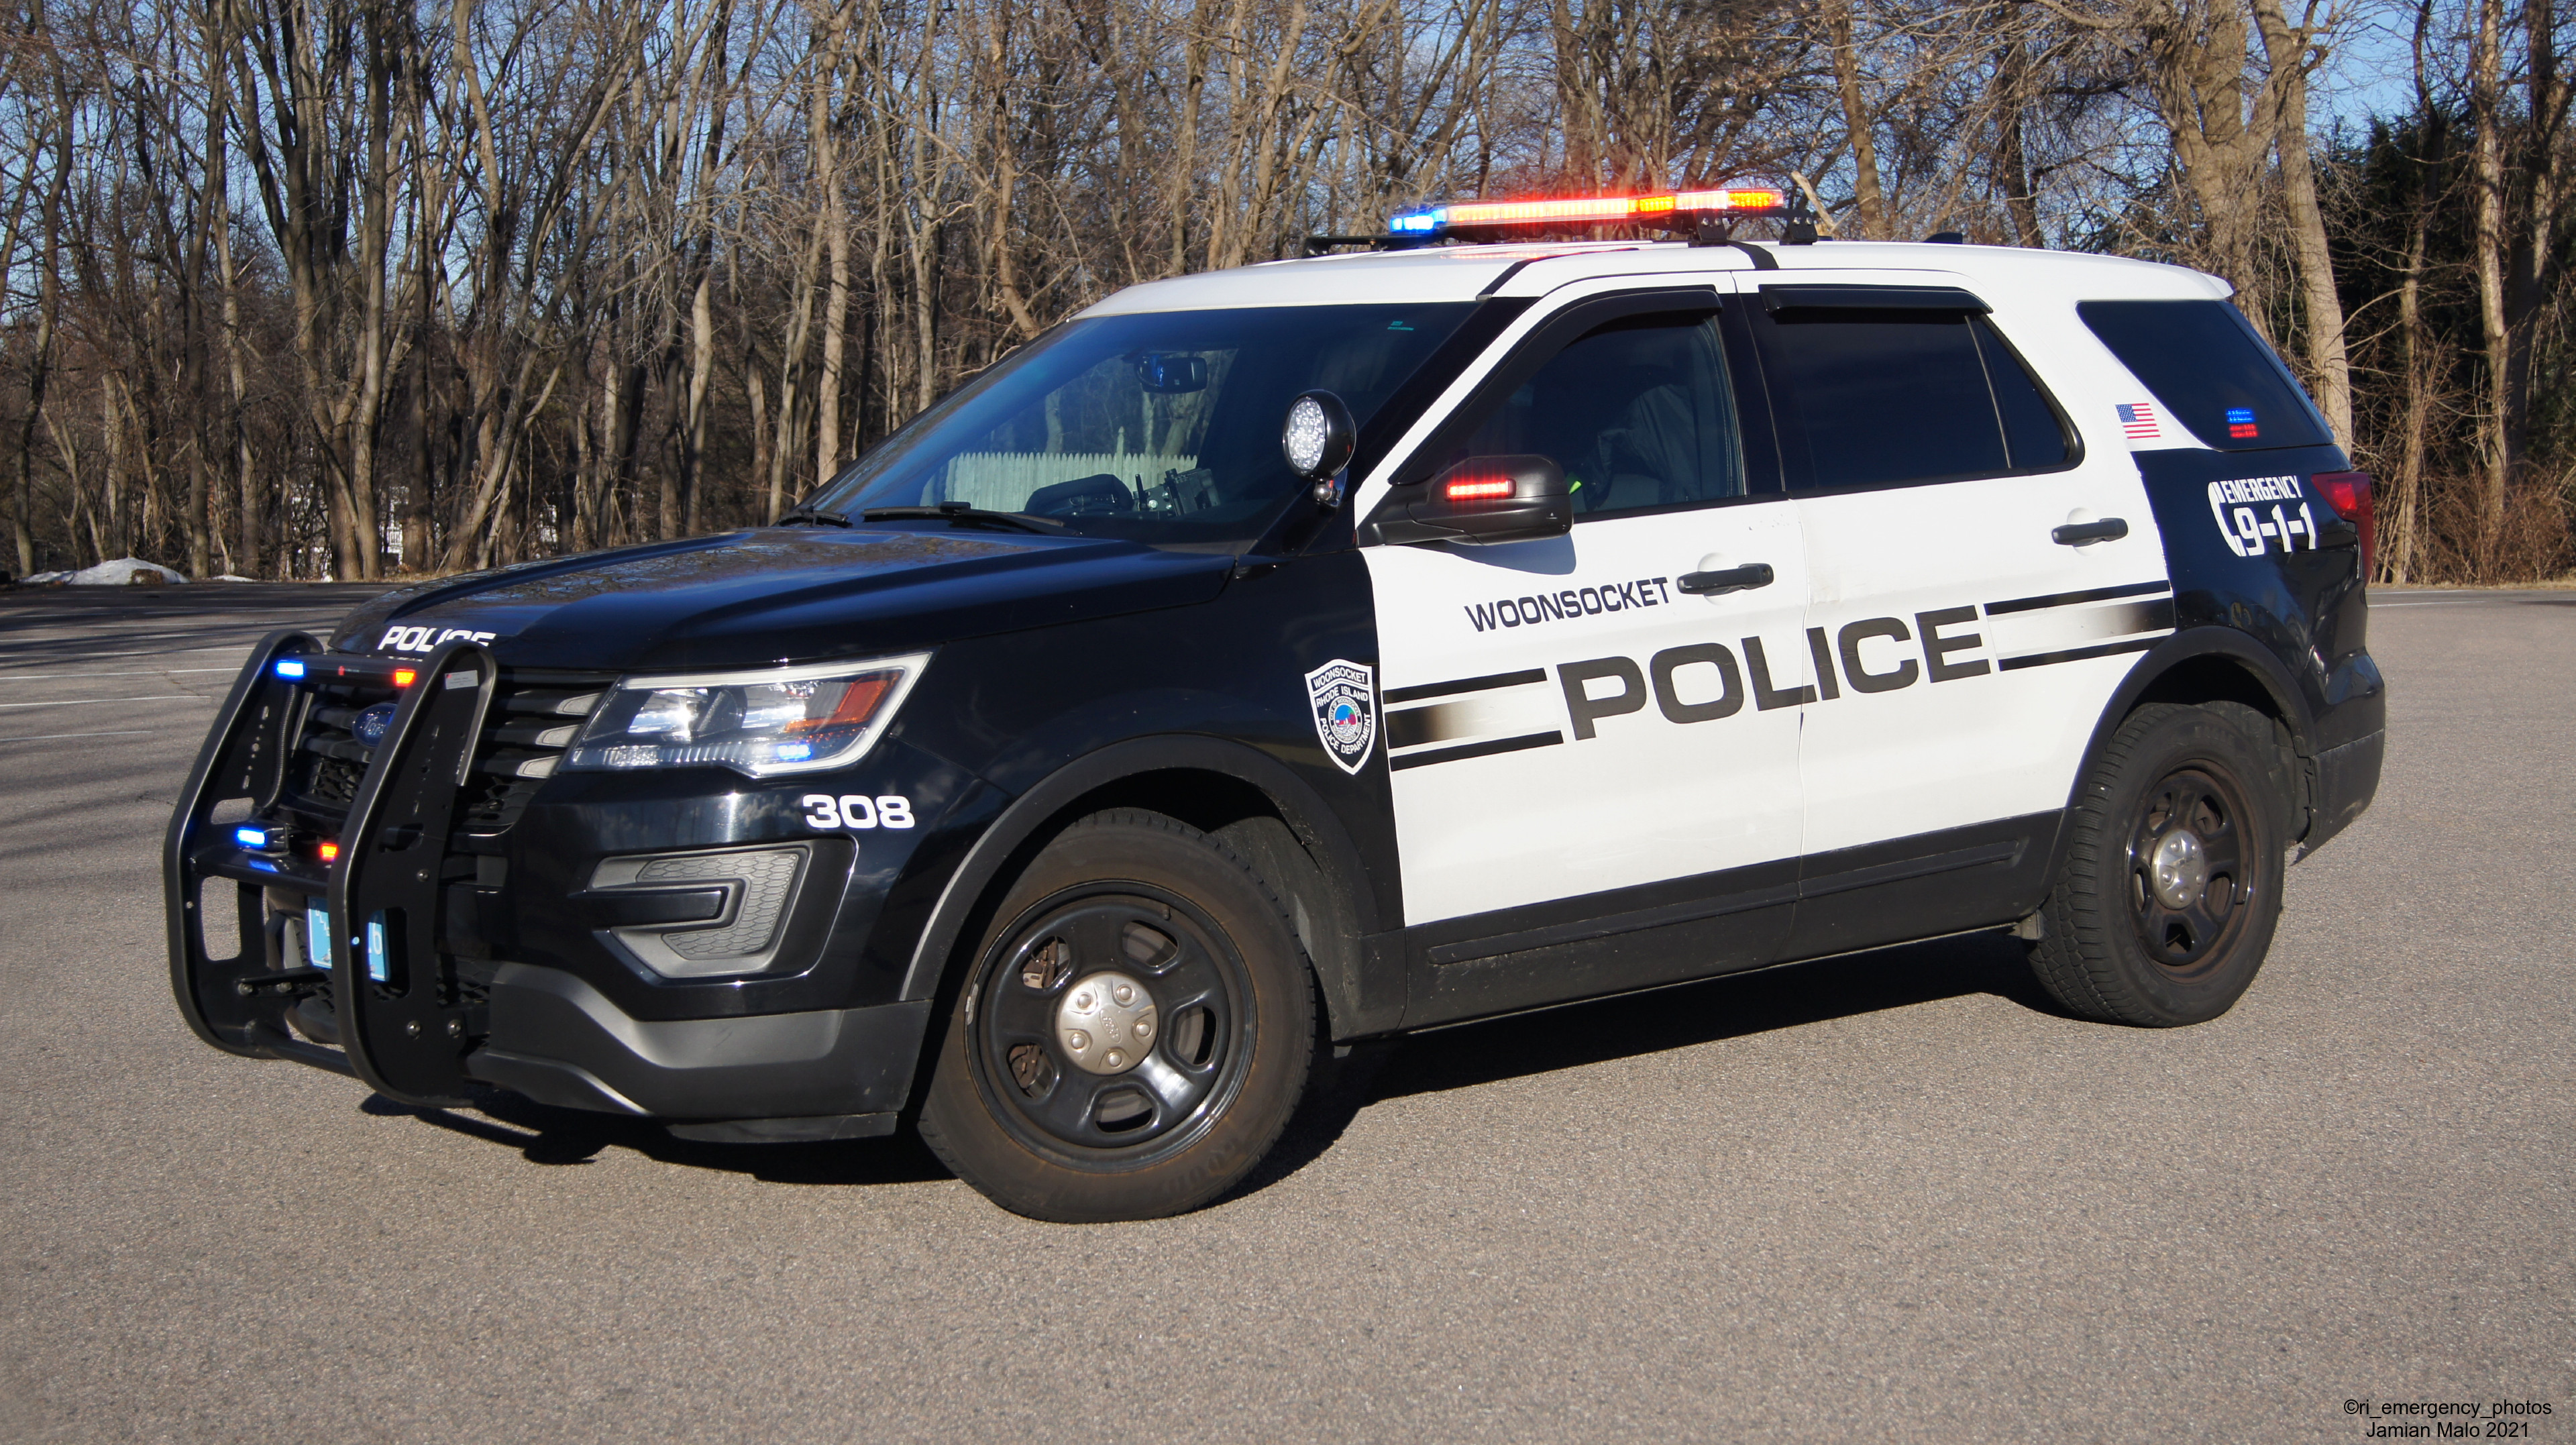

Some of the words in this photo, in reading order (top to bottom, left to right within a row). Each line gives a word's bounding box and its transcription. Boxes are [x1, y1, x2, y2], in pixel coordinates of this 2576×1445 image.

[2220, 475, 2303, 503] EMERGENCY
[2233, 502, 2317, 556] 9-1-1
[1464, 577, 1669, 632] WOONSOCKET
[1313, 667, 1366, 688] WOONSOCKET
[1556, 605, 1990, 741] POLICE
[1316, 686, 1340, 708] RHODE
[1341, 685, 1368, 702] ISLAND
[1320, 718, 1340, 750] POLICE
[1340, 713, 1371, 754] DEPARTMENT
[802, 794, 916, 829] 308
